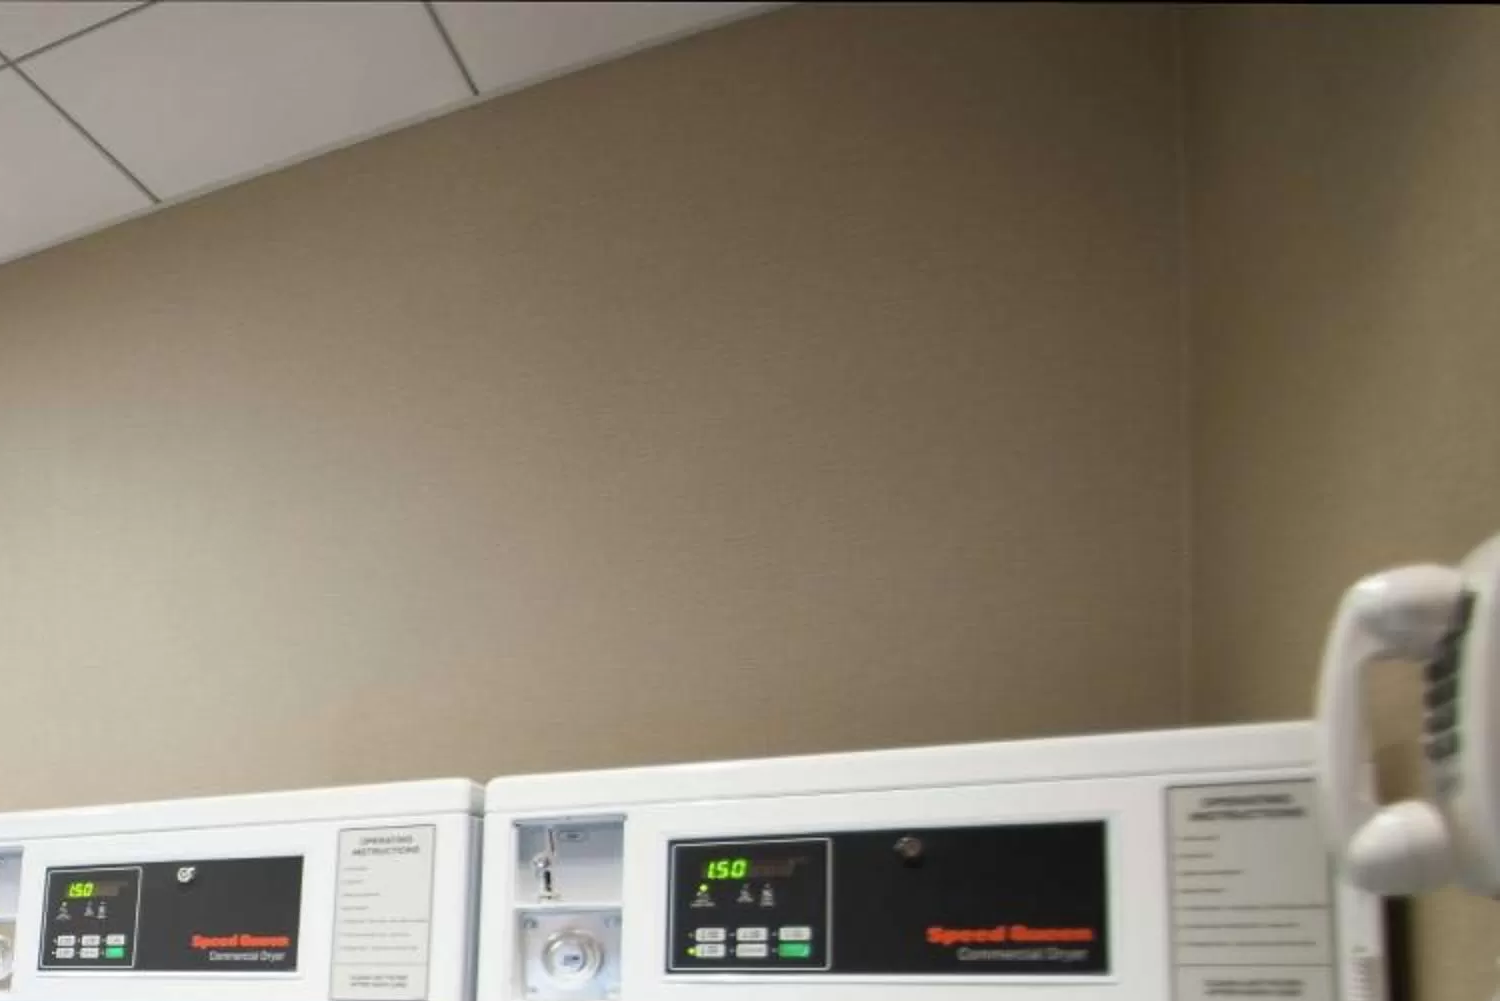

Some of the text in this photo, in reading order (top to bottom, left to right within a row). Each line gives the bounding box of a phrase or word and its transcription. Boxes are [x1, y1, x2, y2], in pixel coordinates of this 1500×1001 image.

[360, 834, 413, 845] OPERATING
[351, 845, 420, 857] INSTRUCTIONS
[191, 933, 238, 949] Speed
[925, 924, 1005, 946] Speed
